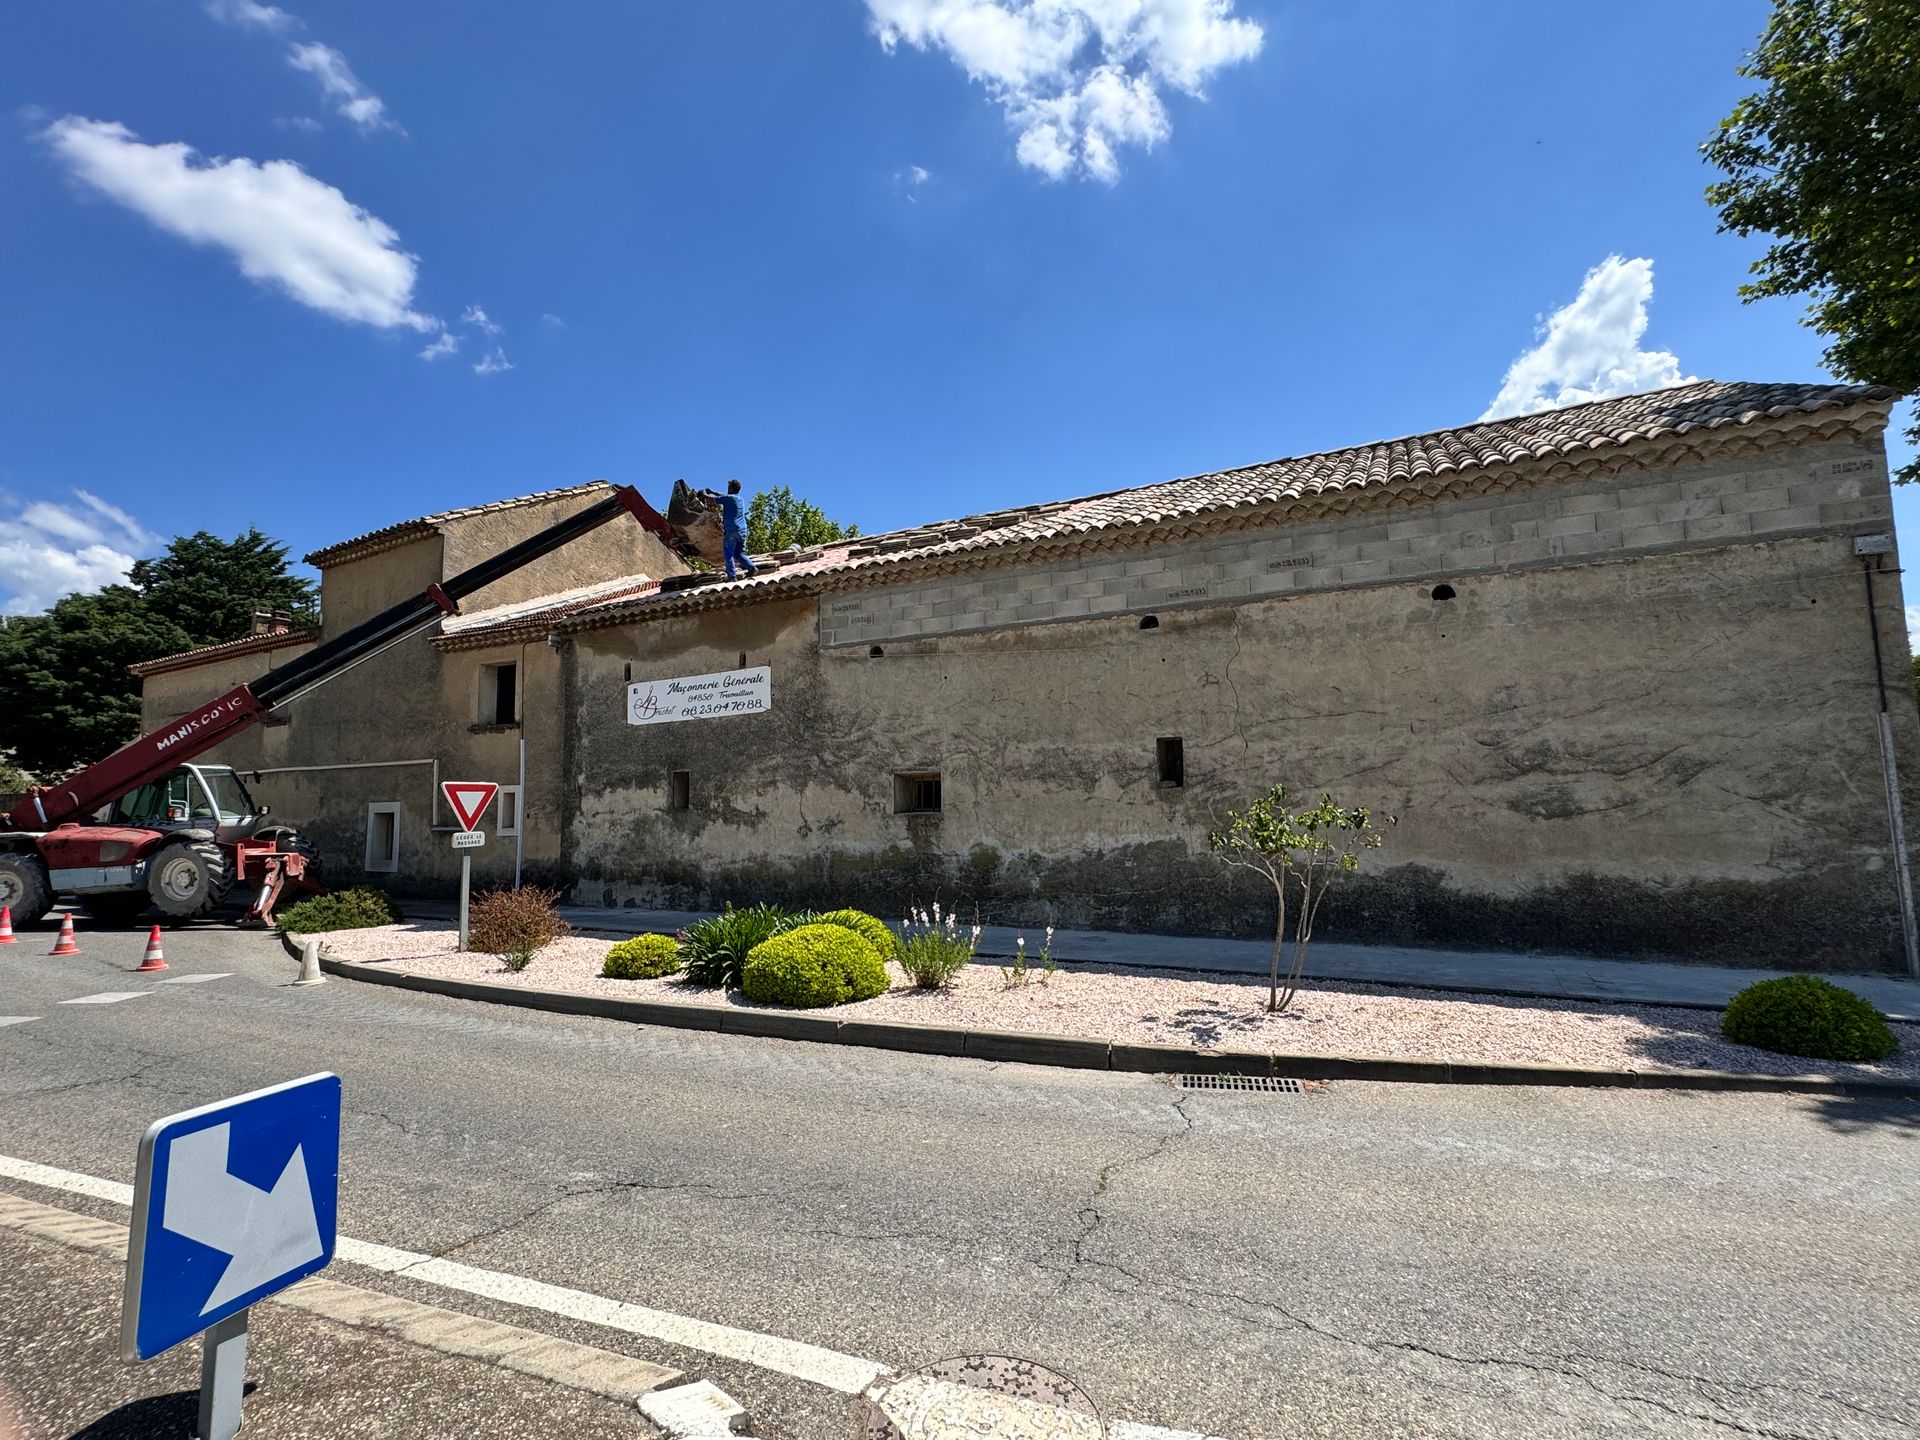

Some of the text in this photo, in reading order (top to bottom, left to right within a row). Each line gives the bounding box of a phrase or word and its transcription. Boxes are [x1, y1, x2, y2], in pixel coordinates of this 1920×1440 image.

[667, 673, 764, 695] Maçonnerie Générale
[156, 697, 243, 751] MANISCOIC
